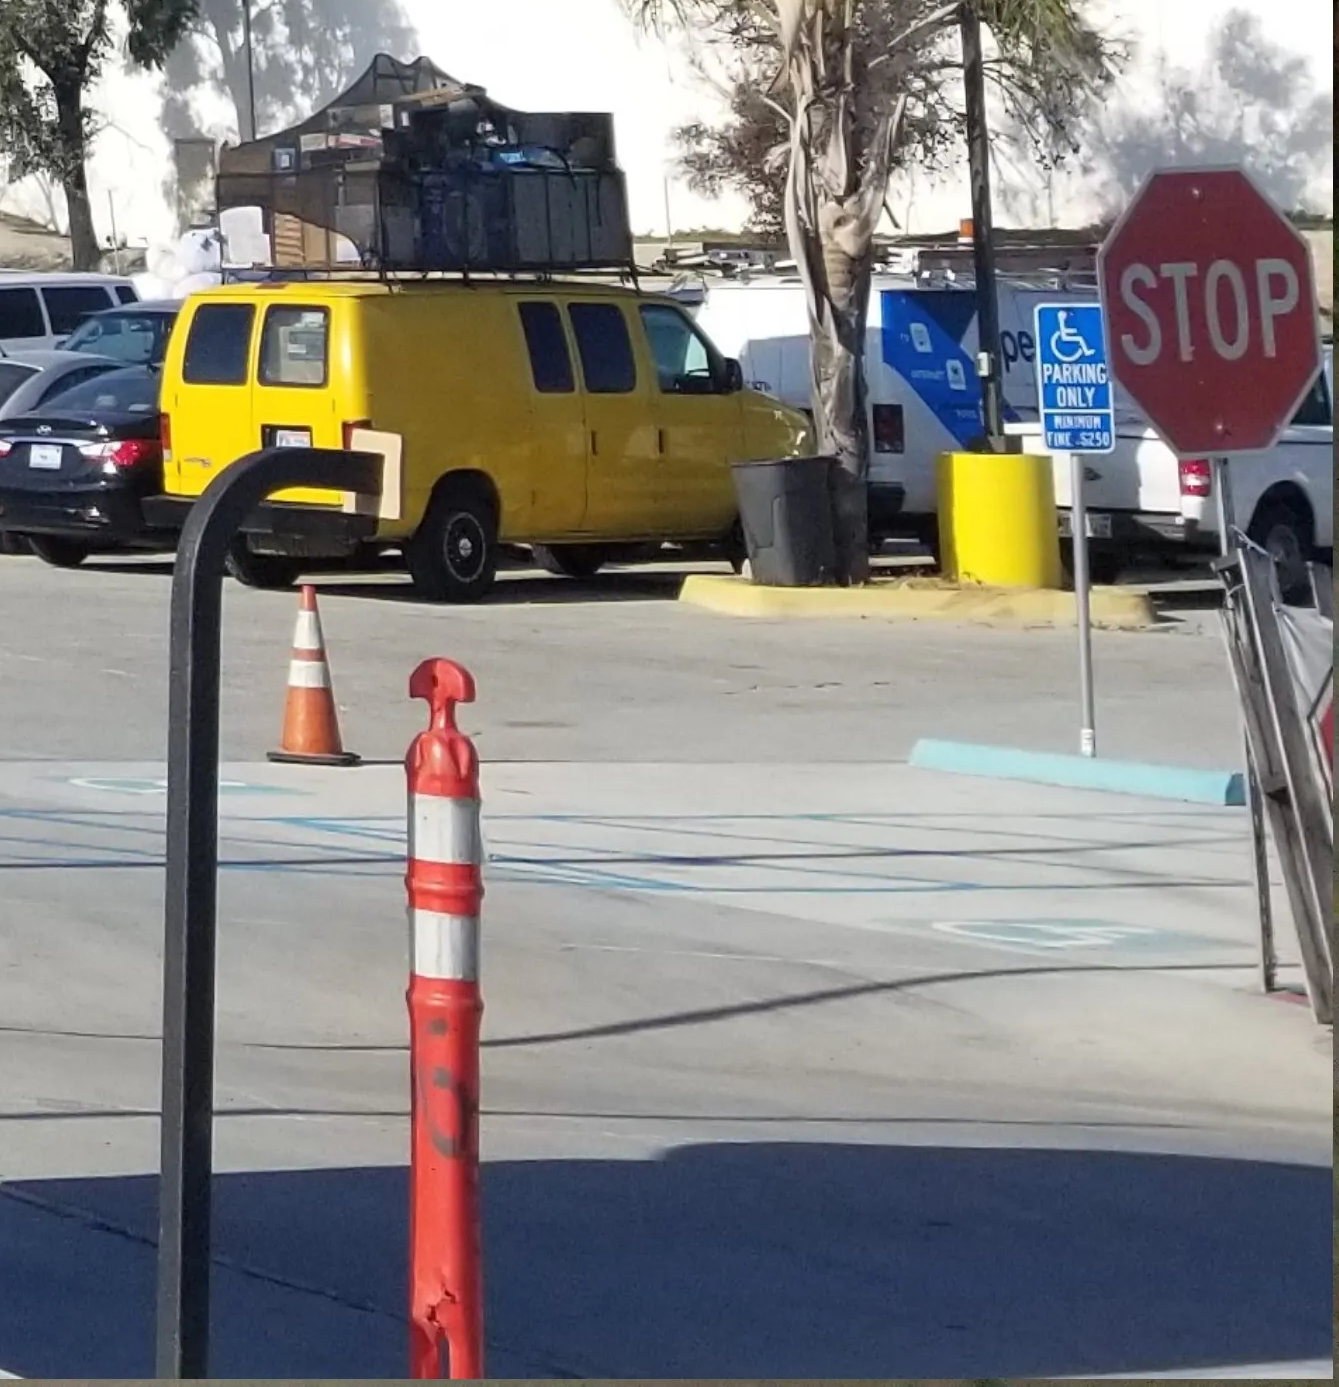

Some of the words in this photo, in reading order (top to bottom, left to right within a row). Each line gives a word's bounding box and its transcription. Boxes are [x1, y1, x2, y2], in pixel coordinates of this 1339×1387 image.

[1120, 259, 1300, 365] STOP
[1043, 363, 1106, 384] PARKING
[1057, 386, 1095, 408] ONLY
[1054, 415, 1101, 429] MINIMUM
